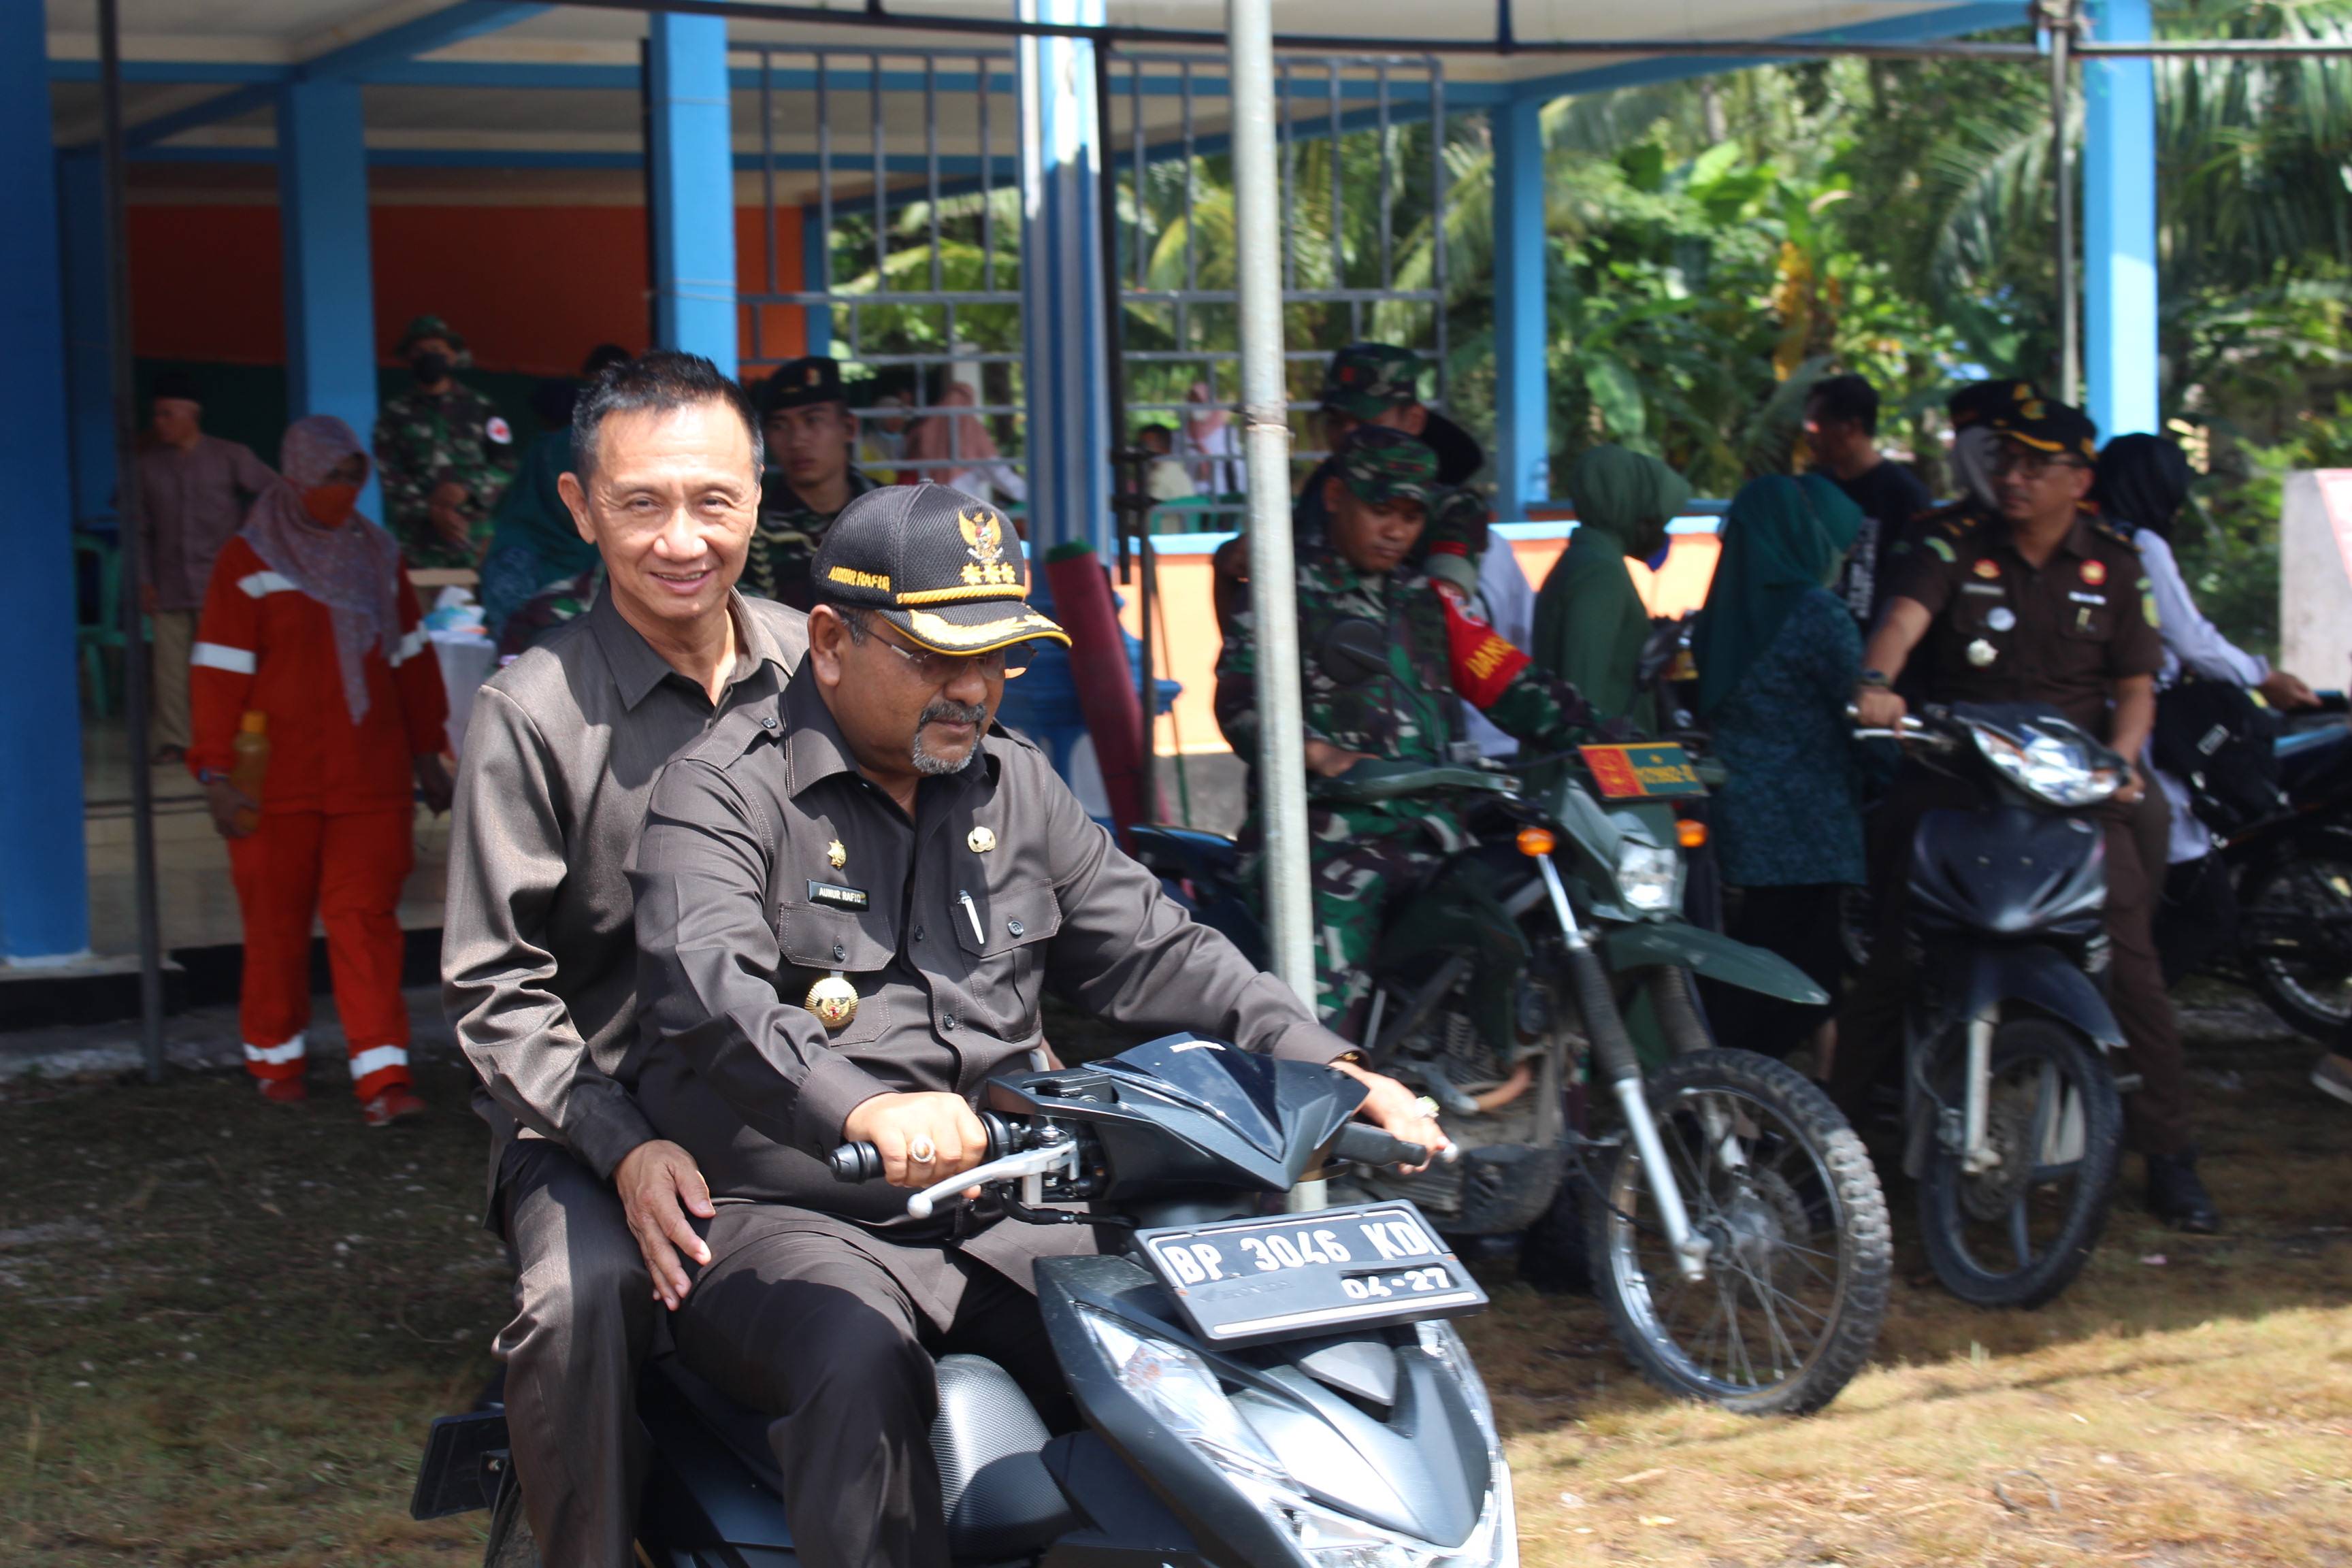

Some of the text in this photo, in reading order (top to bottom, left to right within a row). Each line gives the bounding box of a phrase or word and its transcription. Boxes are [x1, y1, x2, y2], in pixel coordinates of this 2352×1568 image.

[856, 572, 890, 592] RAFIQ
[819, 887, 841, 900] AUNUR
[1162, 1222, 1430, 1284] BP 3046 KD
